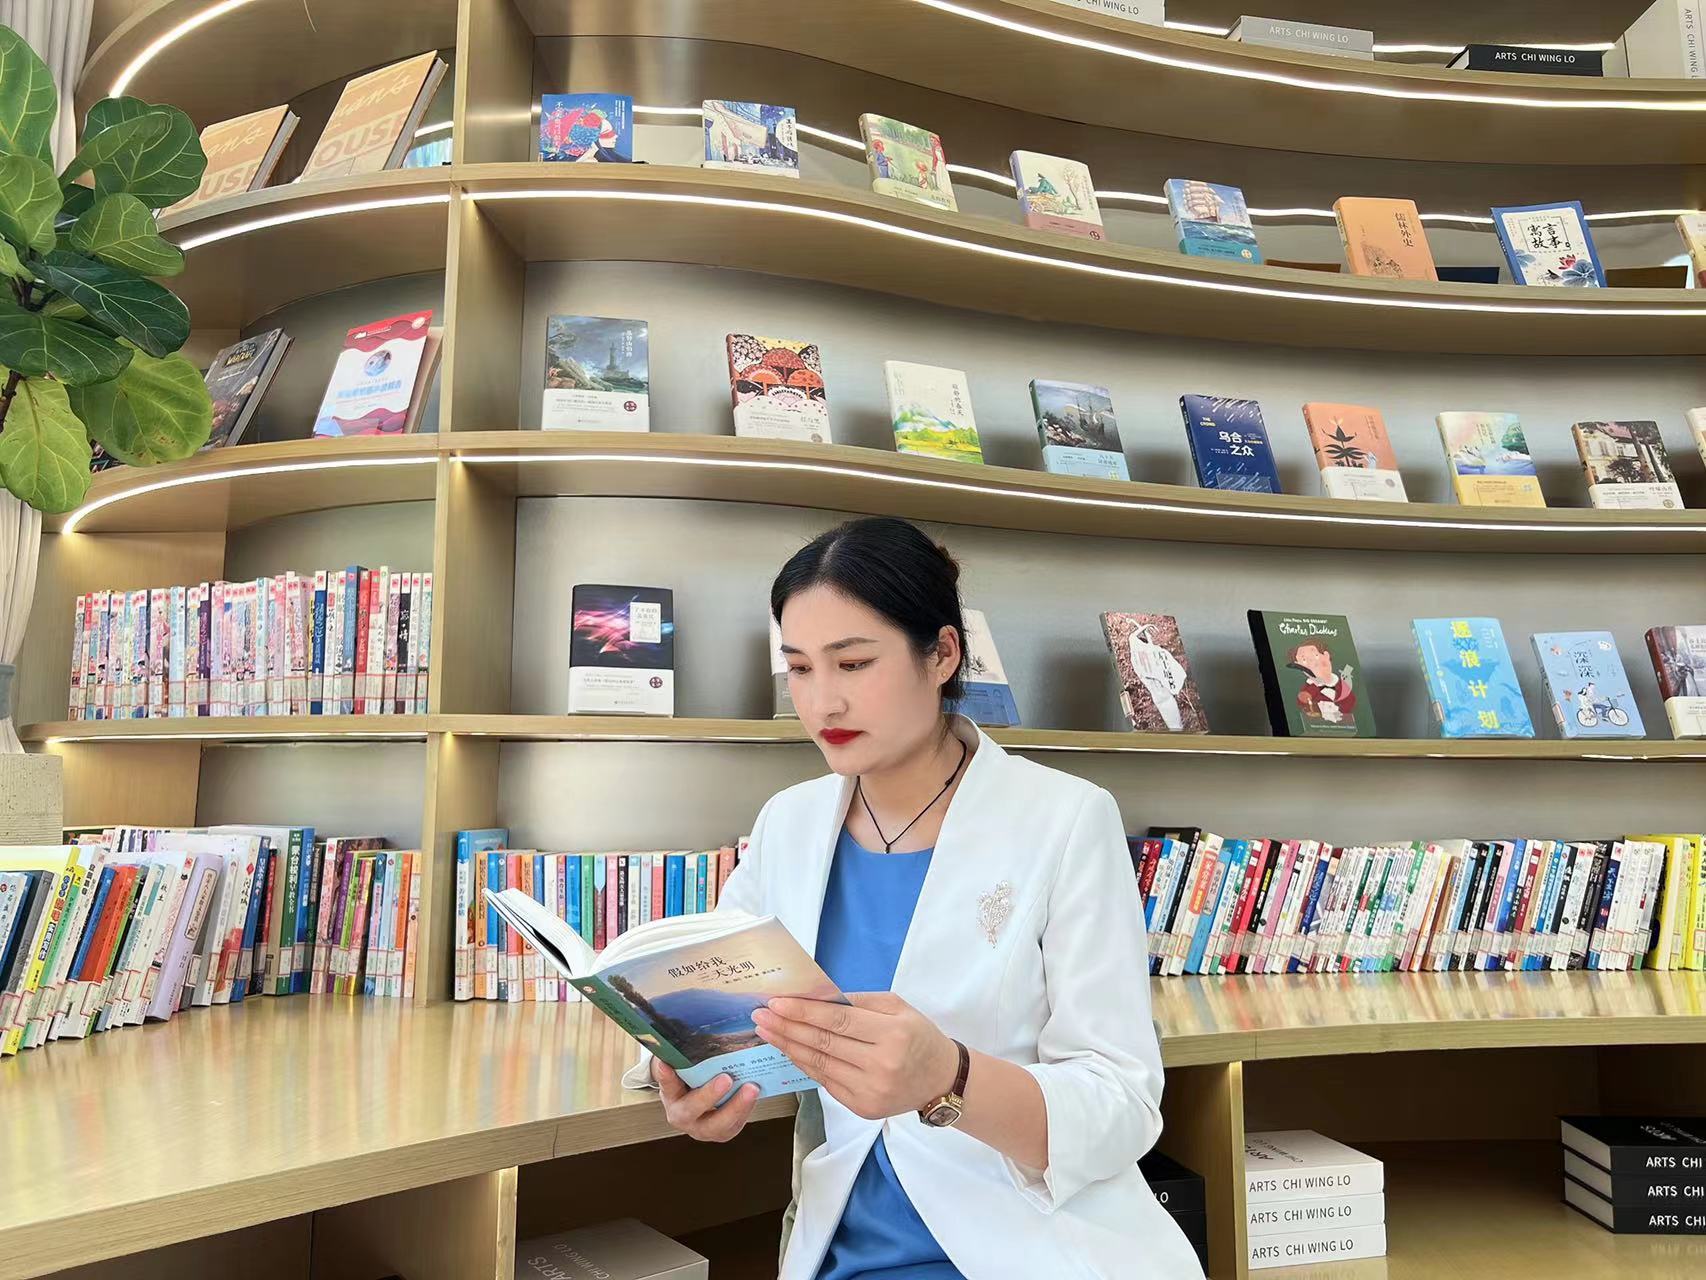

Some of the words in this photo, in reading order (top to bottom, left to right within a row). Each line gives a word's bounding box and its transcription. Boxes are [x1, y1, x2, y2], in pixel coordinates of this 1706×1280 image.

[1103, 0, 1126, 12] WING
[1128, 6, 1139, 15] LO
[1684, 8, 1693, 29] ARTS
[1269, 25, 1291, 36] ARTS
[1295, 29, 1310, 38] CHI
[1312, 31, 1335, 41] WING
[1337, 35, 1349, 43] LO
[1687, 33, 1695, 48] CHI
[1495, 52, 1517, 60] ARTS
[1521, 53, 1537, 61] CHI
[1539, 54, 1562, 62] WING
[1564, 55, 1575, 63] LO
[1689, 50, 1698, 73] WING
[1395, 212, 1414, 248] 儒林外史
[1527, 223, 1558, 237] 寓言
[1532, 235, 1563, 250] 故事
[1218, 431, 1243, 443] 乌合
[1229, 444, 1255, 457] 之众
[1279, 622, 1308, 636] Charles
[1309, 623, 1338, 637] Dickens
[668, 956, 725, 978] 假如给我
[697, 960, 756, 982] 三天光明
[1645, 1156, 1676, 1168] ARTS
[1682, 1157, 1702, 1168] CHI
[1249, 1180, 1277, 1192] ARTS
[1283, 1178, 1302, 1190] CHI
[1305, 1176, 1334, 1188] WING
[1337, 1174, 1351, 1186] LO
[1647, 1185, 1678, 1197] ARTS
[1683, 1185, 1704, 1197] CHI
[1250, 1212, 1278, 1224] ARTS
[1284, 1210, 1303, 1221] CHI
[1306, 1207, 1335, 1219] WING
[1338, 1205, 1352, 1217] LO
[1648, 1215, 1679, 1226] ARTS
[1685, 1215, 1706, 1226] CHI
[1252, 1246, 1280, 1259] ARTS
[1286, 1244, 1305, 1256] CHI
[1308, 1241, 1337, 1253] WING
[1340, 1239, 1354, 1251] LO
[527, 1256, 572, 1280] ARTS
